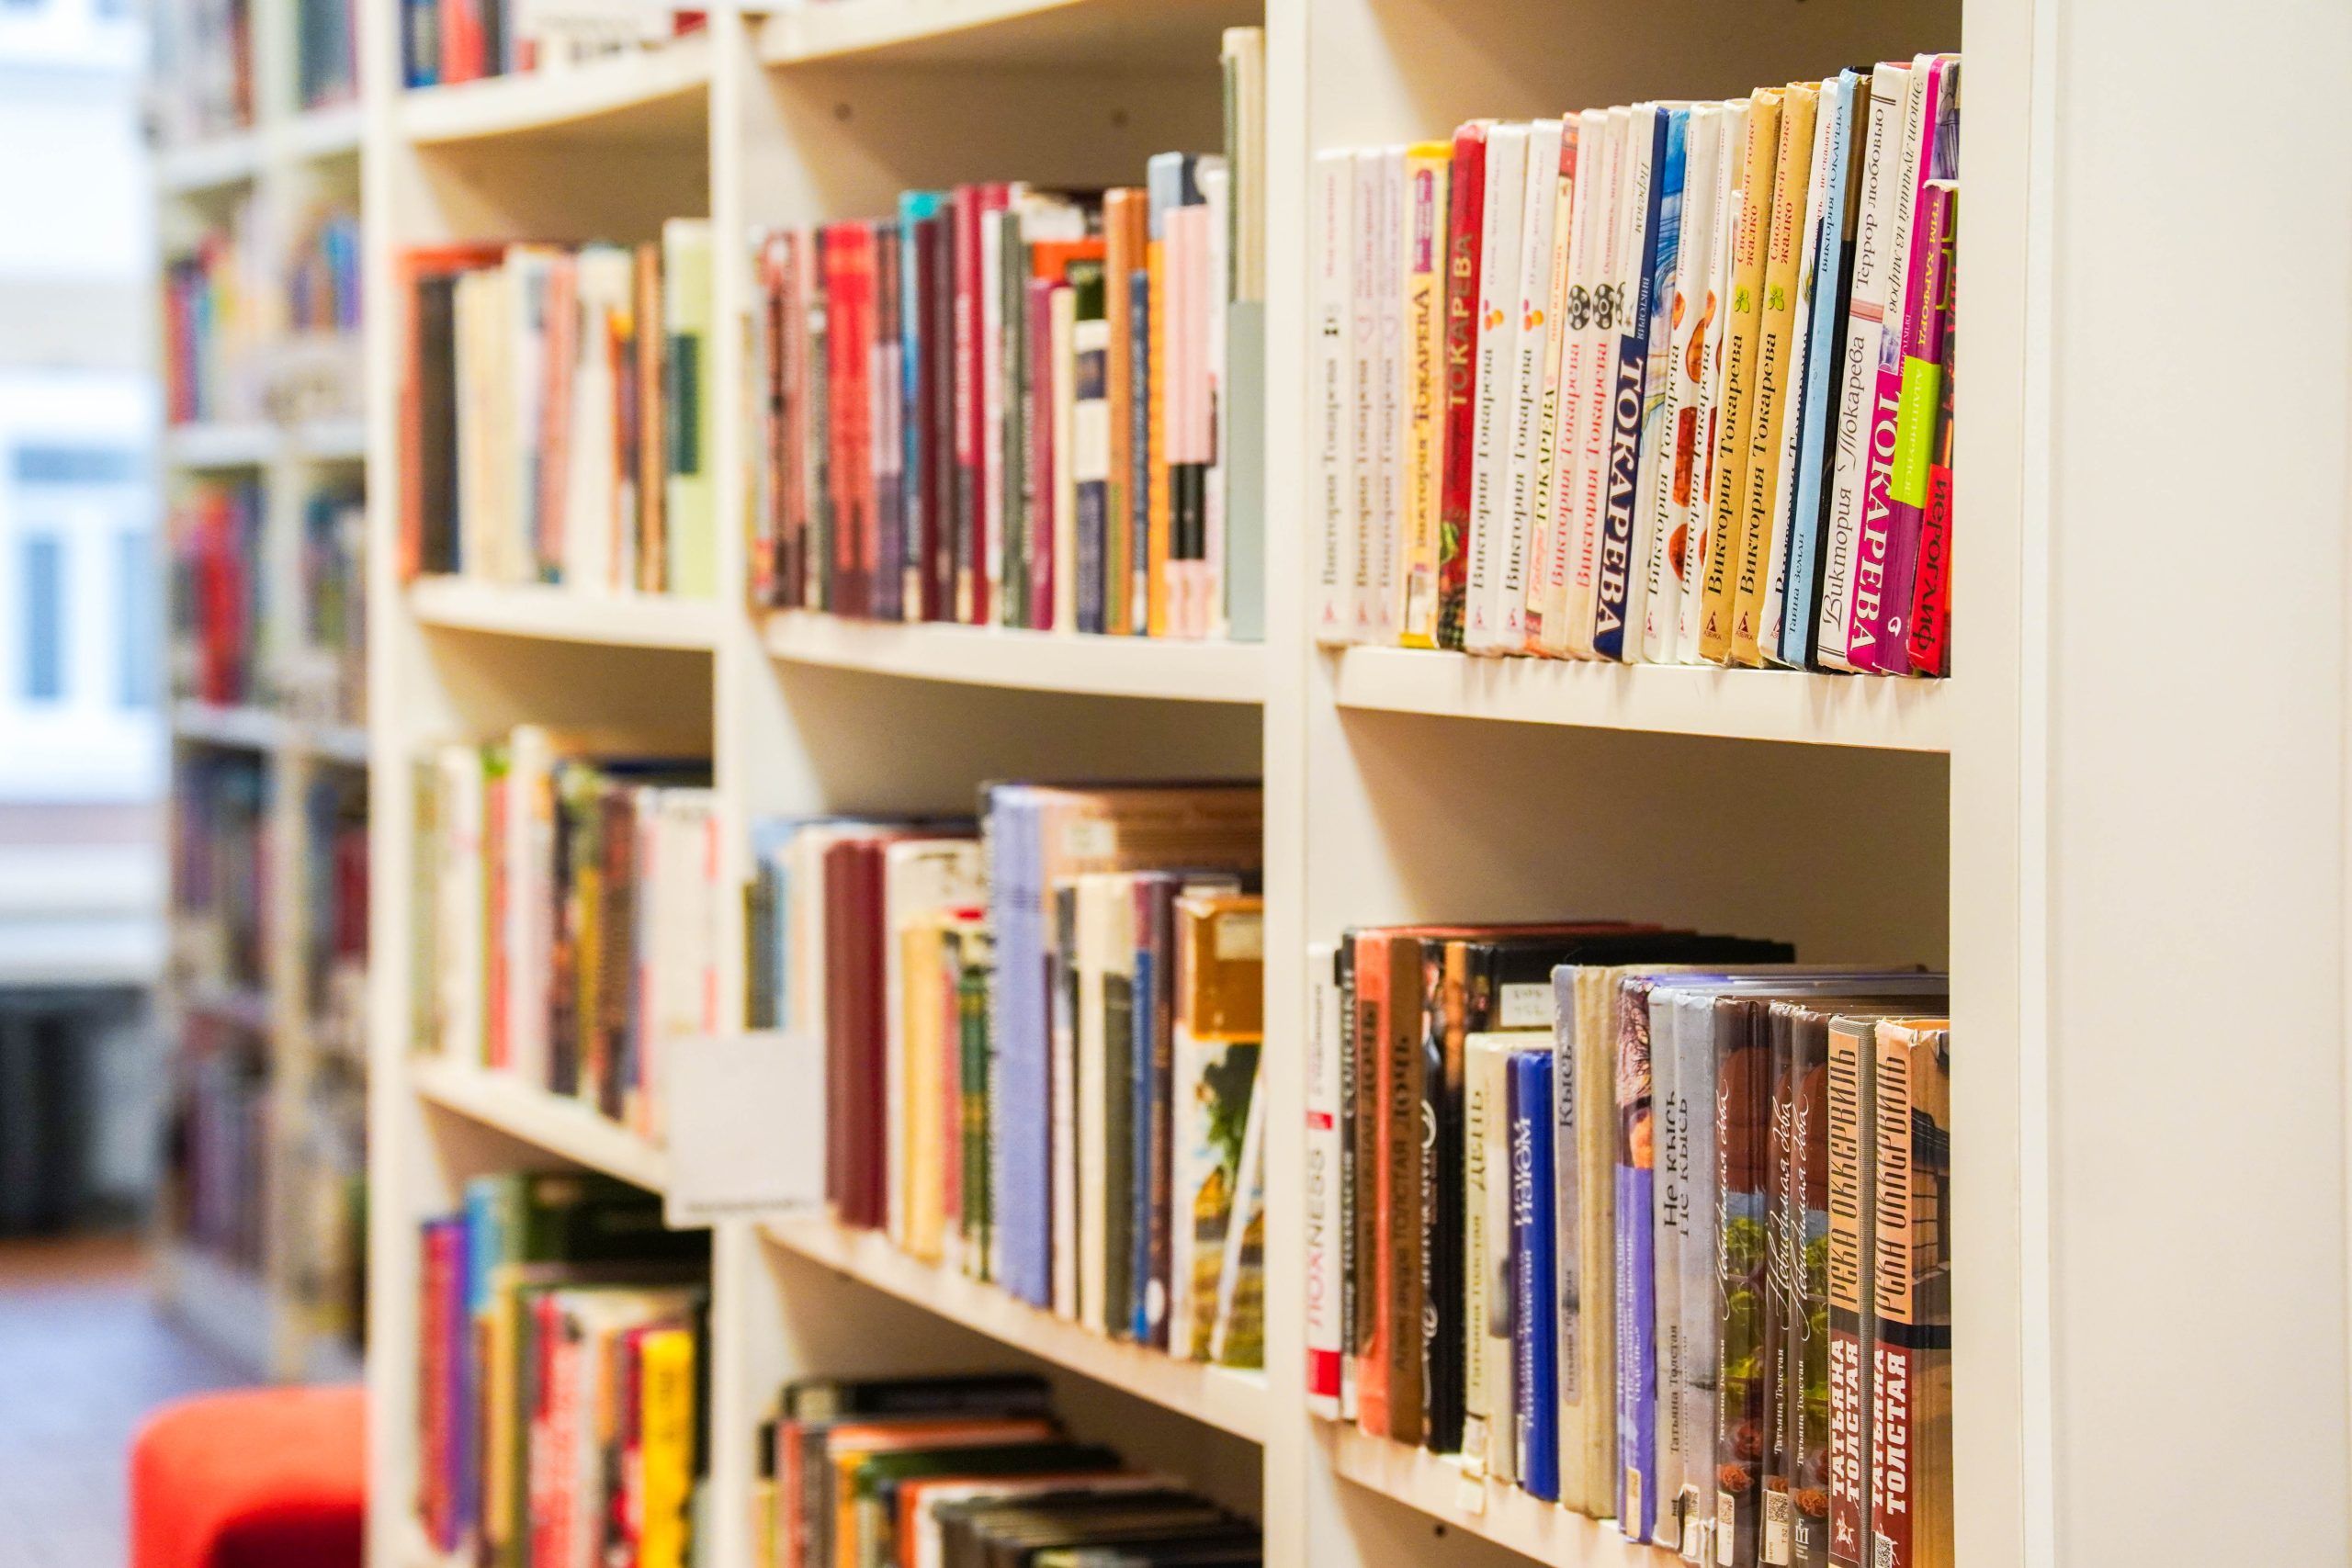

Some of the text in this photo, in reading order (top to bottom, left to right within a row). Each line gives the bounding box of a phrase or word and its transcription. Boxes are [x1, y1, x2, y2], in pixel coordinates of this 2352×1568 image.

[1634, 162, 1651, 234] Перелом
[1736, 118, 1756, 264] Сволочей тоже
[1745, 205, 1758, 268] жалко
[1770, 115, 1792, 261] Сволочей тоже
[1779, 202, 1794, 265] жалко
[1854, 107, 1885, 289] Террор любовью
[1886, 75, 1924, 314] Этот лучший из миров
[1448, 232, 1474, 411] ТОКАРЕВА
[1636, 276, 1652, 341] ВИКТОРИЯ
[1917, 199, 1940, 345] ТИМ ХАРФОРД
[1472, 349, 1495, 590] Виктория Токарева
[1505, 349, 1533, 591] Виктория Токарева
[1535, 389, 1555, 522] ТОКАРЕВА
[1550, 344, 1580, 588] Виктория Токарева
[1575, 343, 1608, 588] Виктория Токарева
[1596, 357, 1645, 637] ТОКАРЕВА
[1647, 344, 1680, 596] Виктория Токарева
[1681, 344, 1712, 596] Виктория Токарева
[1706, 334, 1745, 596] Виктория Токарева
[1739, 333, 1776, 596] Виктория Токарева
[1822, 336, 1867, 632] Виктория Токарева
[1849, 390, 1902, 652] ТОКАРЕВА
[1789, 533, 1805, 635] Тайна Земли
[1470, 1090, 1487, 1191] ДЕНЬ
[1558, 1043, 1574, 1128] Кысь
[1663, 1090, 1679, 1227] Не кысь
[1714, 1078, 1730, 1321] Невидимая дева
[1766, 1085, 1792, 1331] Невидимая дева
[1789, 1094, 1811, 1342] Невидимая дева
[1829, 1048, 1858, 1305] РЕКА ОККЕРВИЛЬ
[1875, 1055, 1907, 1316] РЕКА ОККЕРВИЛЬ
[1669, 1324, 1681, 1454] Татьяна Толстая
[1719, 1392, 1727, 1443] Татьяна
[1773, 1348, 1784, 1455] Татьяна Толстая
[1795, 1359, 1805, 1467] Татьяна Толстая
[1830, 1338, 1846, 1498] ТАТЬЯНА
[1846, 1339, 1860, 1504] ТОЛСТАЯ
[1872, 1348, 1884, 1509] ТАТЬЯНА
[1886, 1350, 1907, 1517] ТОЛСТАЯ
